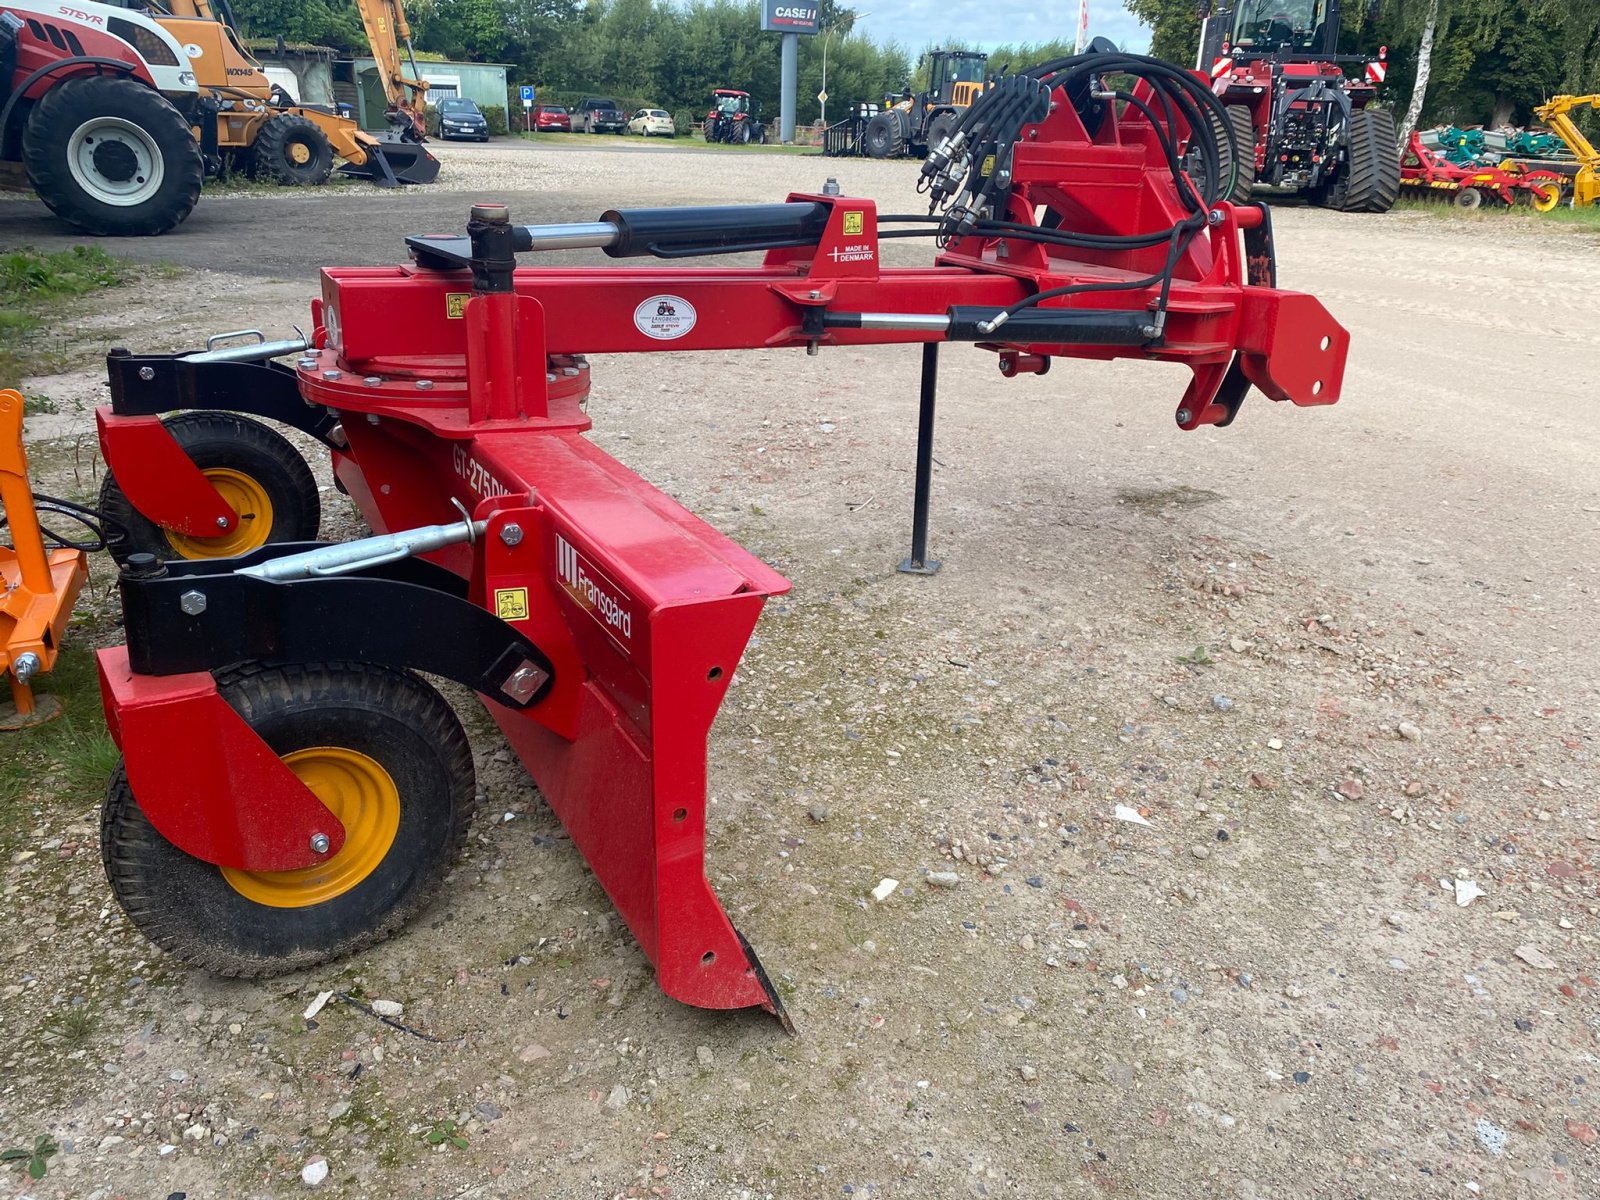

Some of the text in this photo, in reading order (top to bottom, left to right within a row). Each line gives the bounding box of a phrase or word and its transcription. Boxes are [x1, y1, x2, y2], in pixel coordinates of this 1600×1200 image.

[58, 6, 103, 25] STEYR
[775, 6, 807, 19] CASE
[523, 88, 531, 99] P
[845, 245, 862, 253] MADE
[840, 253, 874, 262] DENMARK
[578, 566, 631, 639] Fransgård
